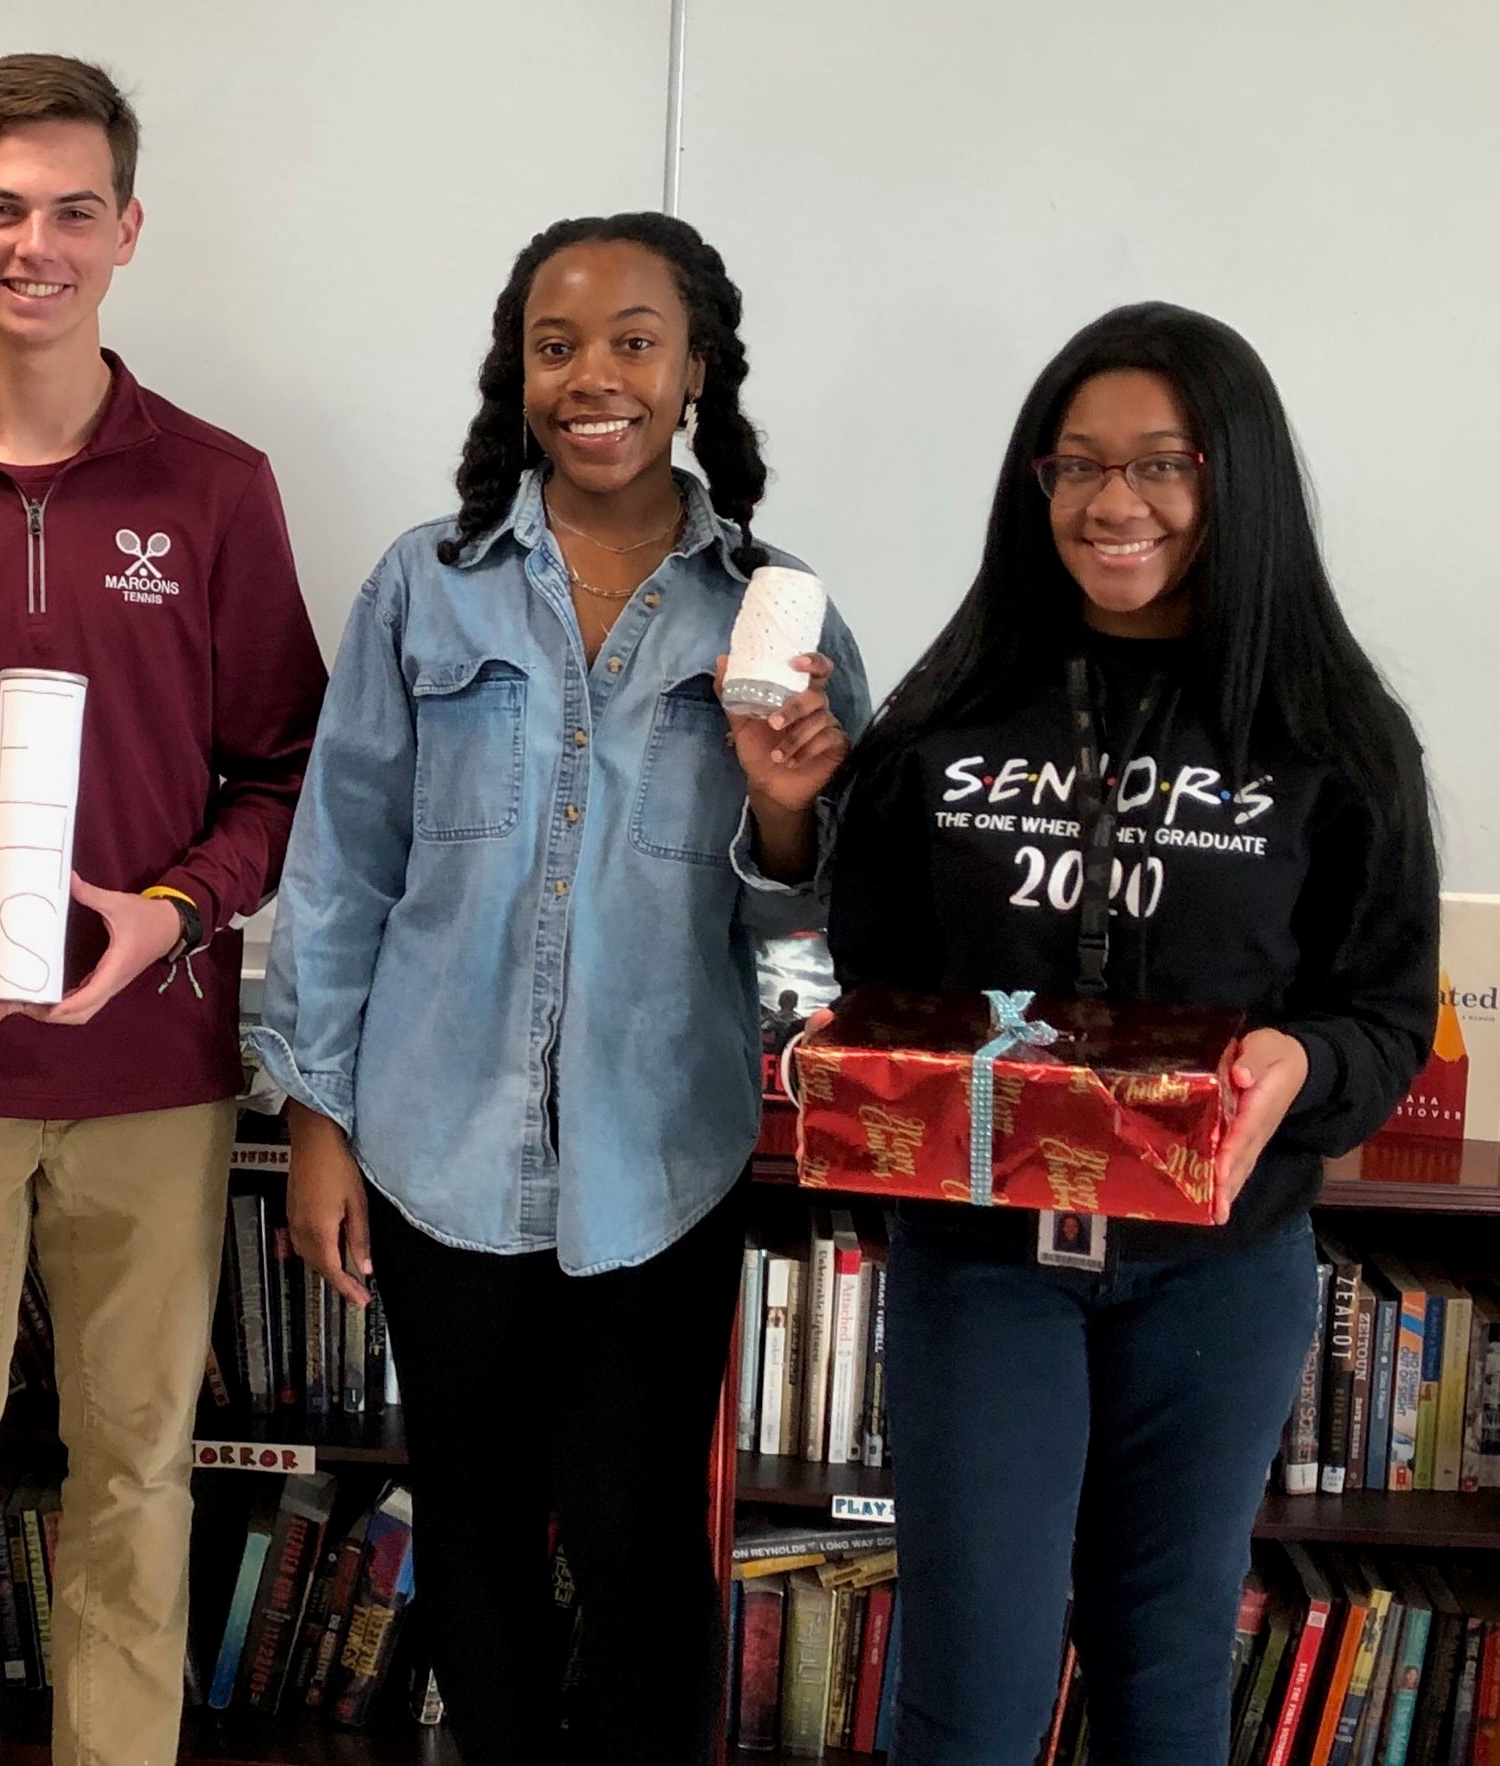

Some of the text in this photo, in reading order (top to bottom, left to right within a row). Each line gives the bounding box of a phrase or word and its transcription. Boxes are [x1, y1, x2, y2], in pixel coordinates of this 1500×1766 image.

[105, 574, 180, 596] MAROONS
[123, 590, 163, 605] TENNIS
[942, 752, 1275, 826] SENORS
[935, 811, 1267, 856] THE ONE WHER HEY GRADUATE
[1008, 846, 1164, 918] 200
[1332, 1276, 1357, 1360] ZEALOT
[1355, 1312, 1371, 1382] ZEITOUN
[1396, 1346, 1411, 1416] OUT OF SIGHT
[750, 1544, 807, 1558] REYNOLDS
[820, 1540, 850, 1551] LONG
[851, 1538, 874, 1548] WAY
